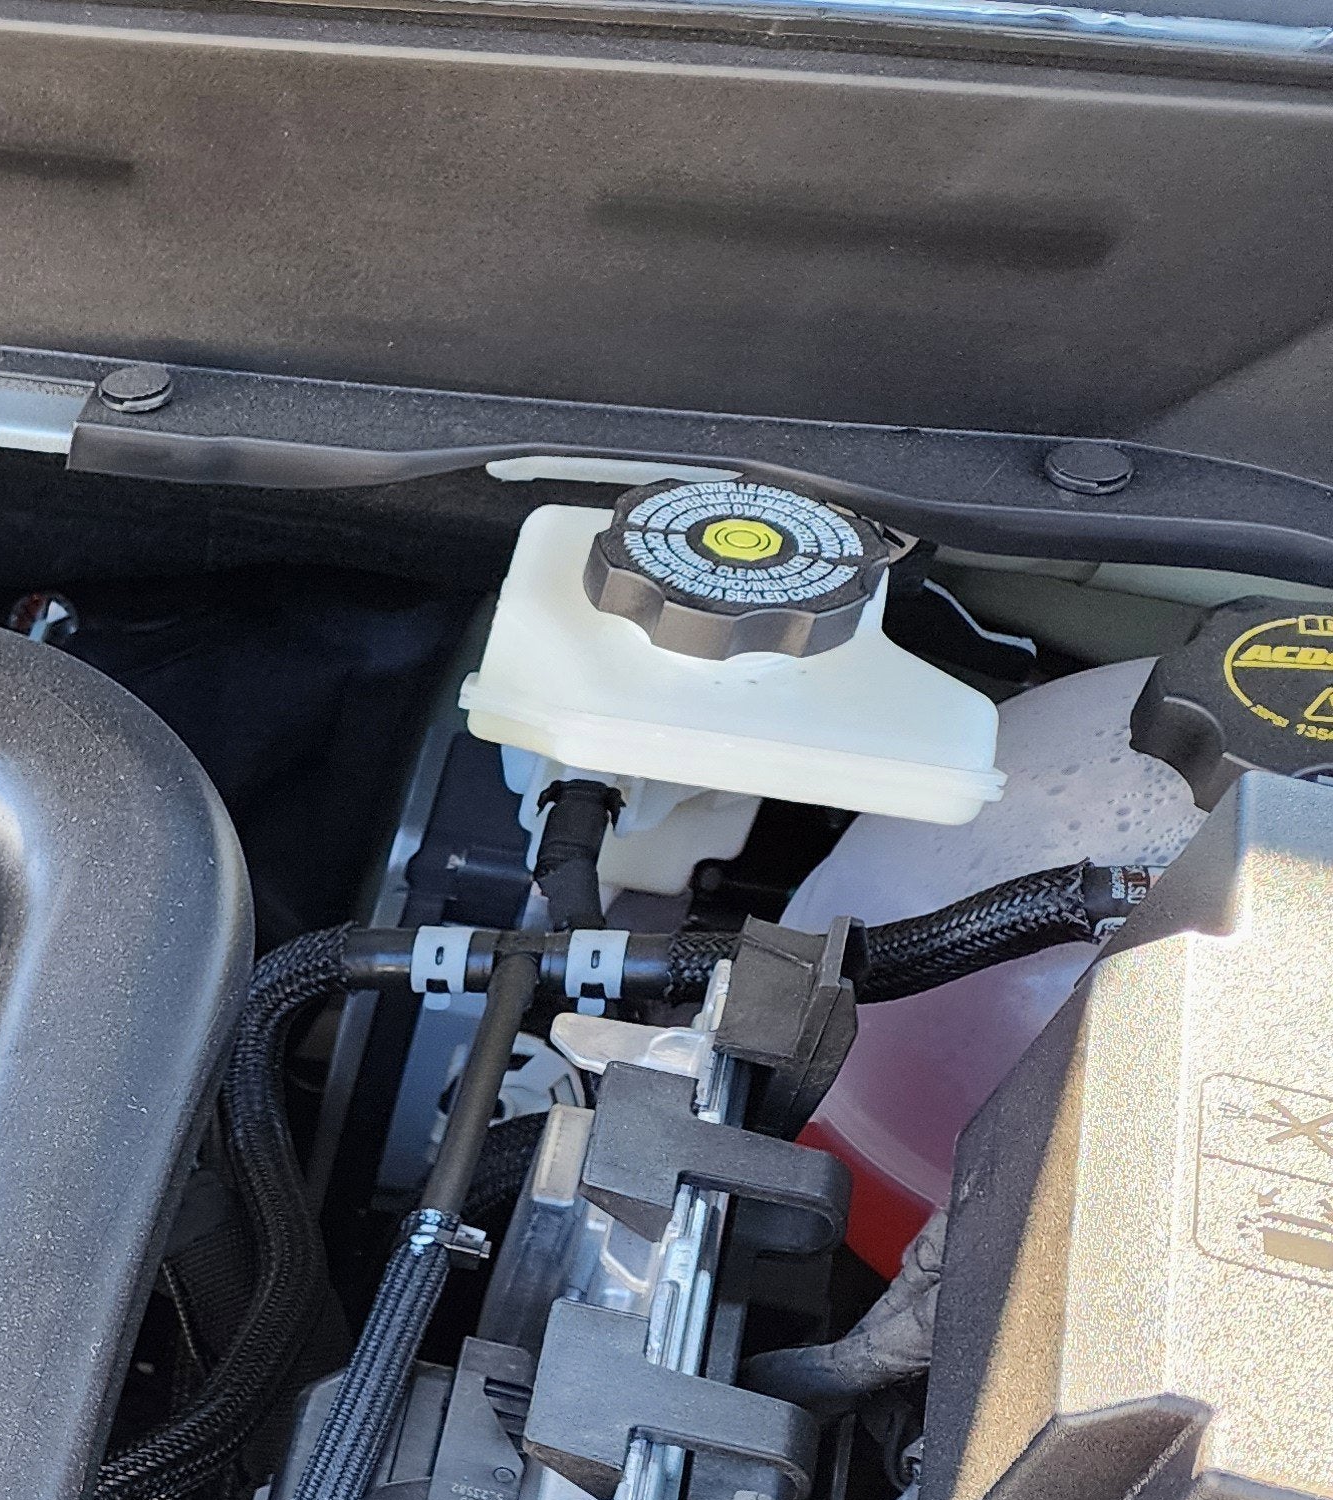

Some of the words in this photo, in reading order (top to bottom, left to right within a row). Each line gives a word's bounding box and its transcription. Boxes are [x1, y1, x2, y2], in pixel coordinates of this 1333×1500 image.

[715, 565, 770, 580] CLEAN
[767, 555, 813, 578] FILLER
[663, 573, 713, 597] FROM
[724, 589, 789, 603] SEALED
